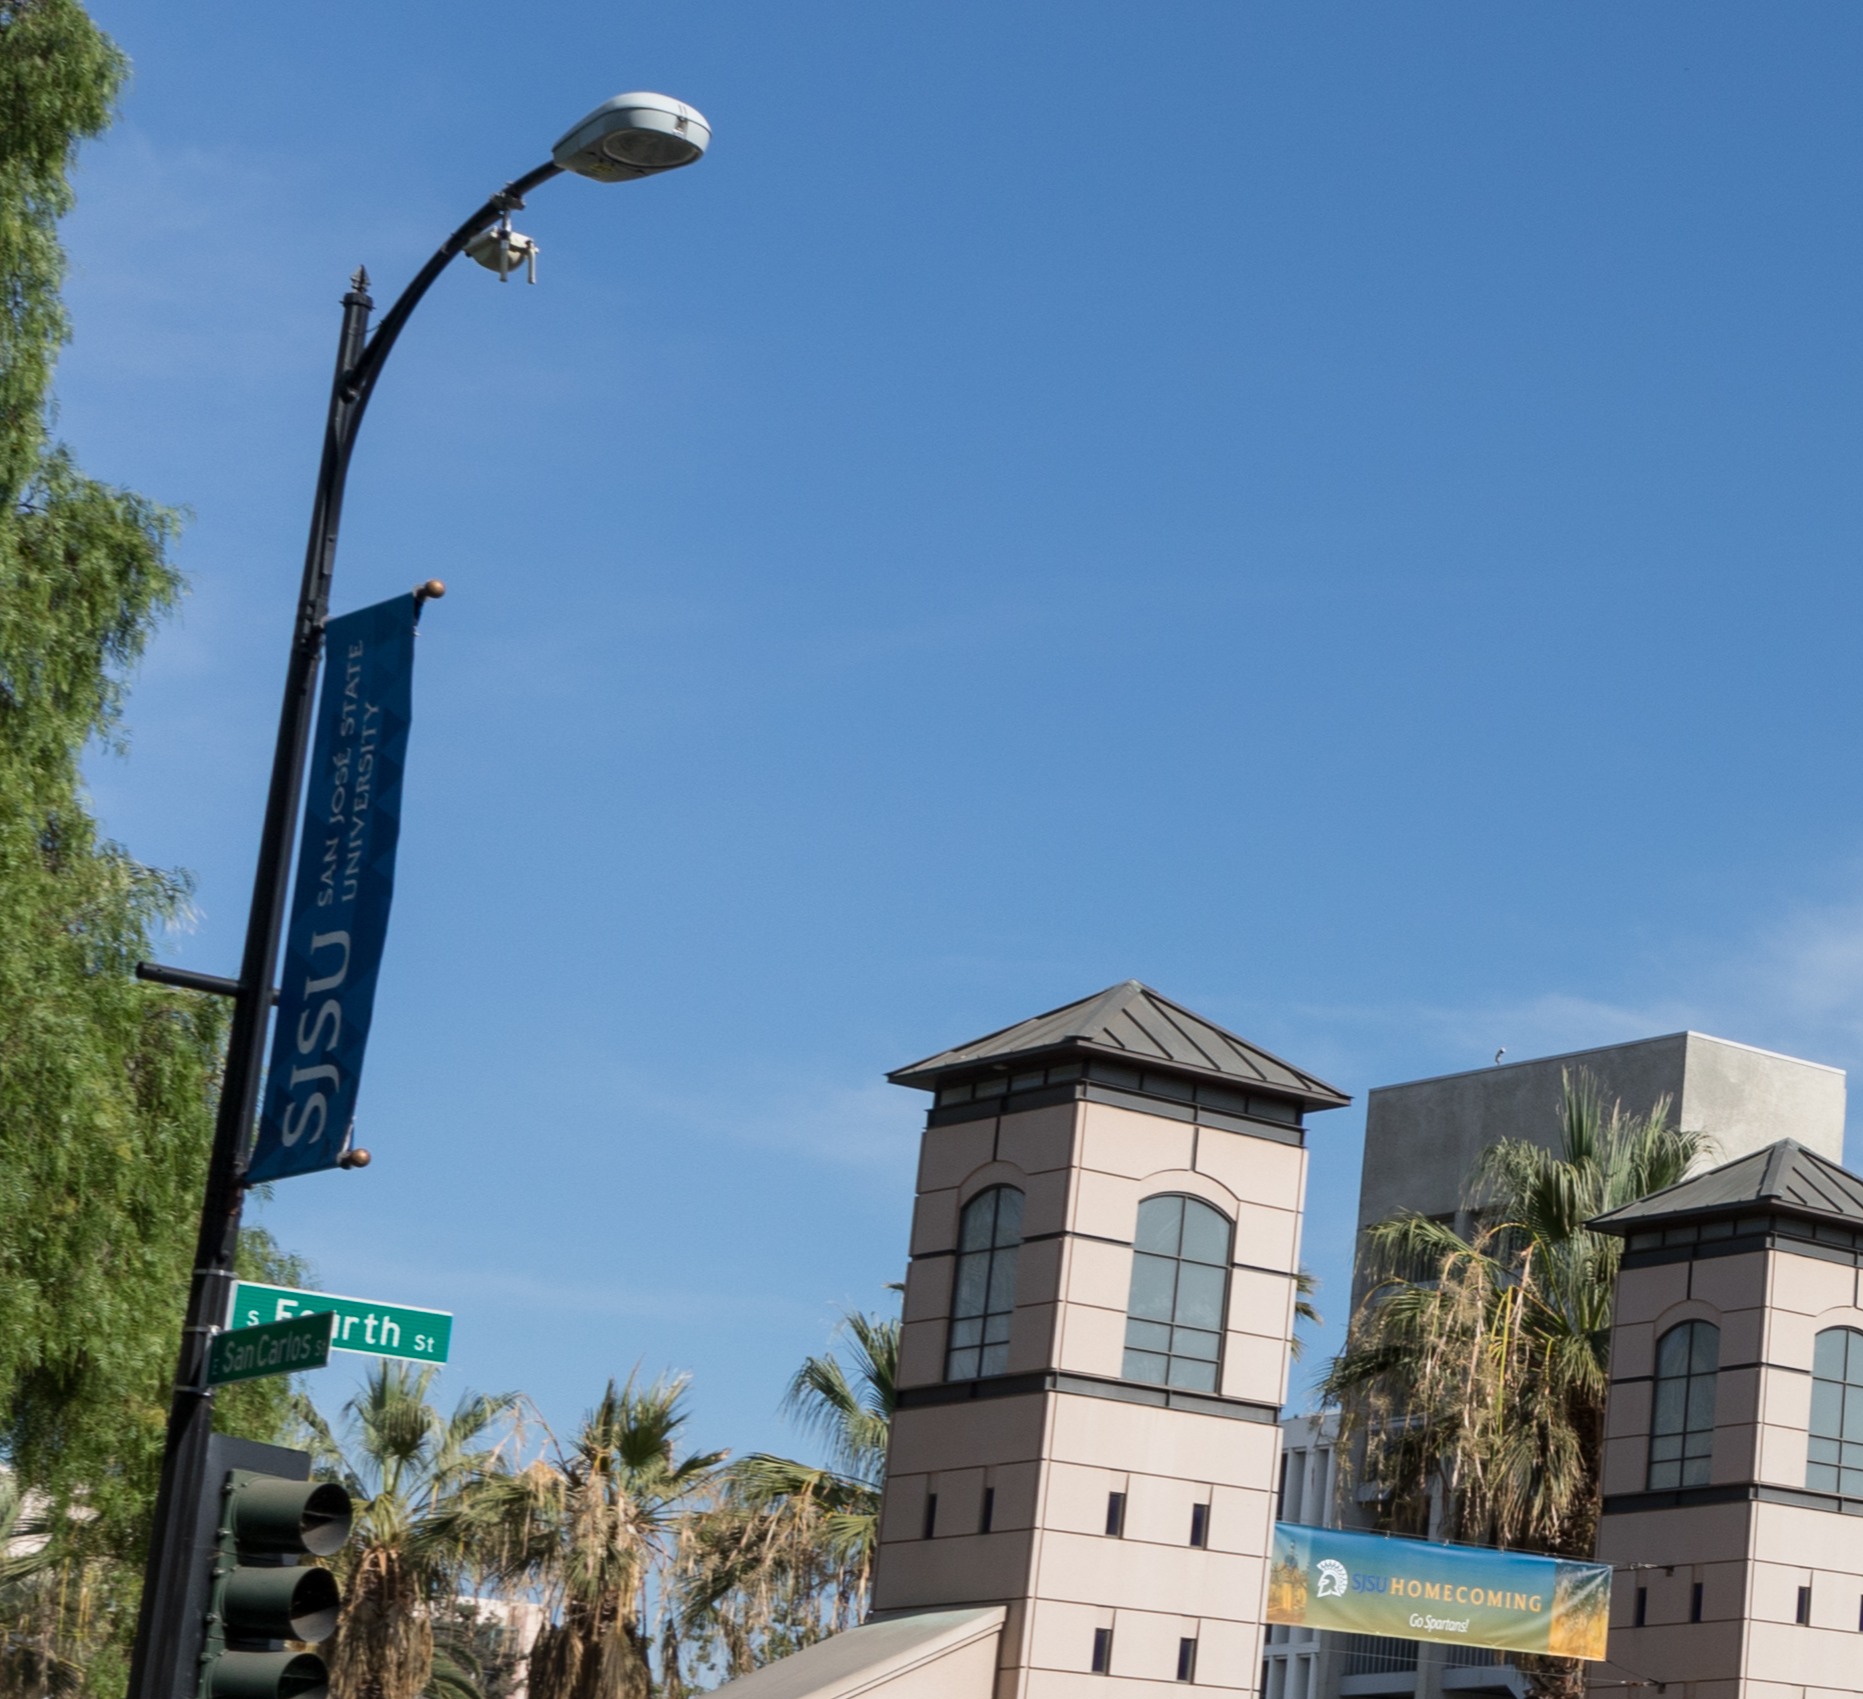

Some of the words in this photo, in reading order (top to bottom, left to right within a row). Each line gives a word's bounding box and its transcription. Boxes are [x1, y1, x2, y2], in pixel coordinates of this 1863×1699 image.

[317, 831, 339, 908] SAN
[340, 639, 363, 735] STATE
[342, 701, 379, 900] UNIVERSITY
[281, 928, 350, 1149] SJSU
[223, 1340, 256, 1373] San
[257, 1331, 312, 1367] Carlos
[414, 1333, 435, 1353] St
[1351, 1572, 1389, 1595] SJSU
[1390, 1578, 1543, 1612] HOMECOMING
[1408, 1612, 1424, 1628] Go
[1423, 1613, 1470, 1633] Spartans!
